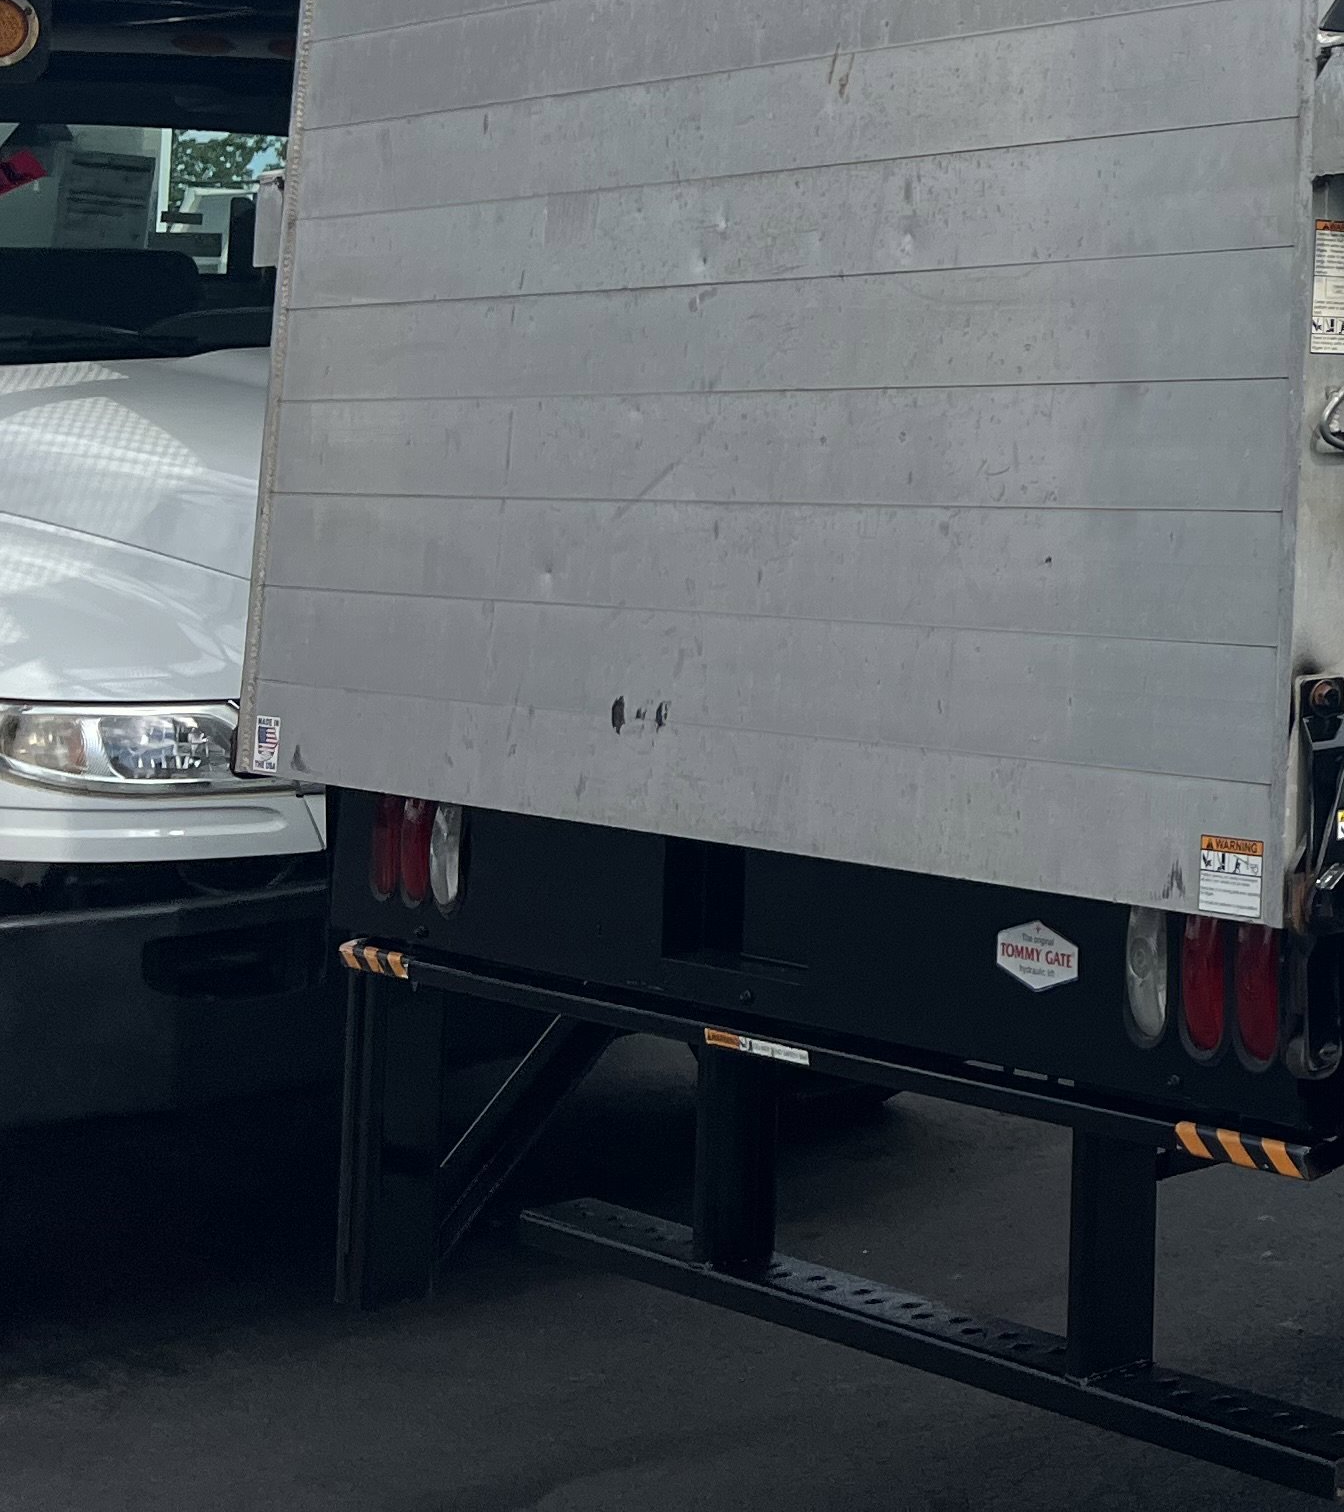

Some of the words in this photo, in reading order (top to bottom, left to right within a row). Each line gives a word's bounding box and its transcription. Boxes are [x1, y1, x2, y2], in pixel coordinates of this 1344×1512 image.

[1215, 838, 1258, 854] WARNING
[1001, 942, 1042, 963] TOMMY
[1045, 950, 1073, 969] GATE
